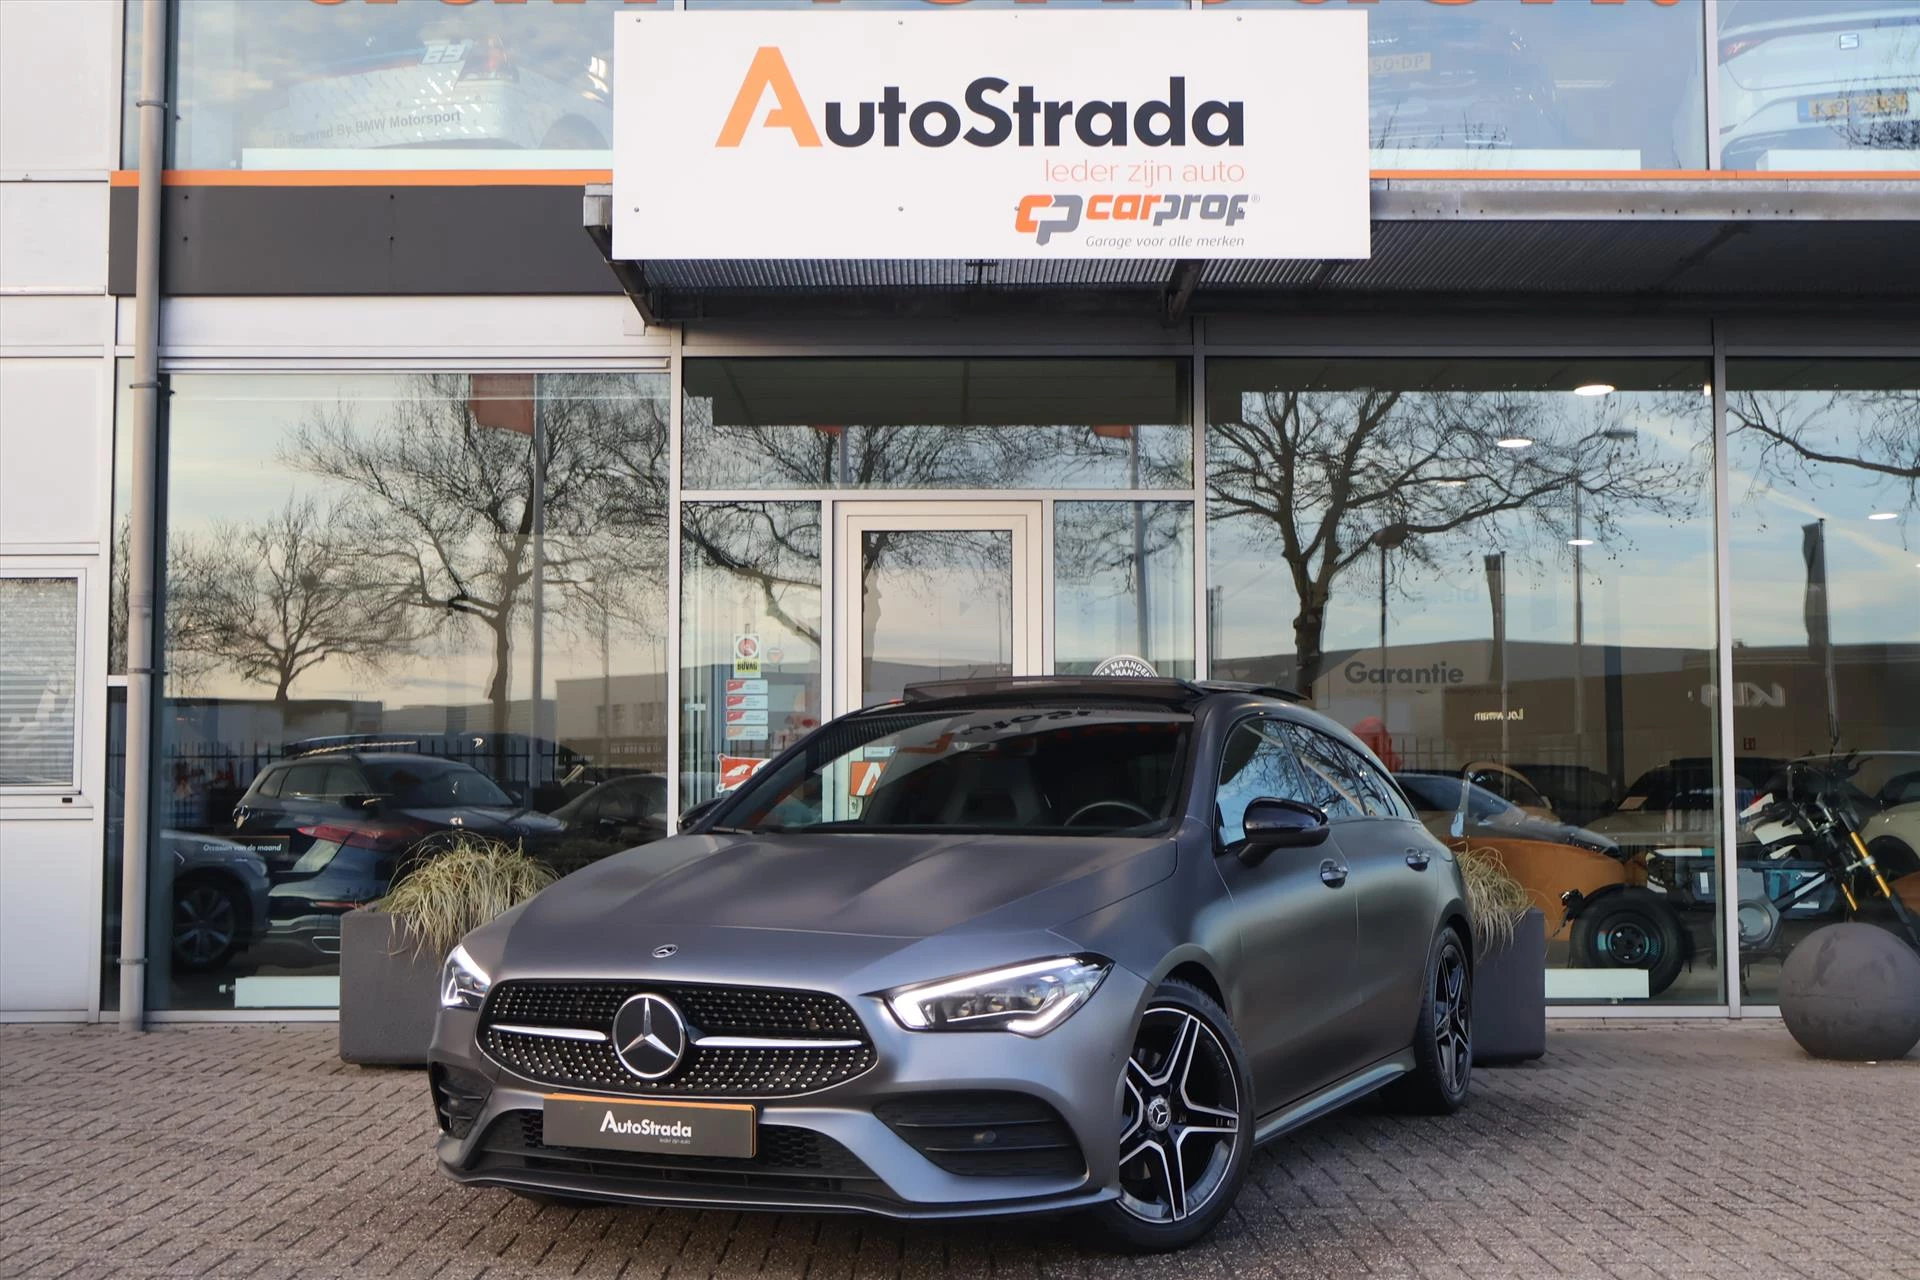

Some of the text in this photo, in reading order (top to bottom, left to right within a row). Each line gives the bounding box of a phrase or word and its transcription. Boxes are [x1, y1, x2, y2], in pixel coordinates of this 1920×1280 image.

[714, 46, 1245, 148] AutoStrada
[355, 119, 386, 134] BMW
[389, 110, 461, 129] Motorsport
[1045, 159, 1245, 188] Ieder zijn auto
[1086, 194, 1249, 226] carprof
[1085, 235, 1245, 249] Garage voor alle merken
[1344, 661, 1464, 684] Garantie
[247, 844, 256, 852] de
[257, 843, 282, 852] maand
[600, 1110, 692, 1137] AutoStrada
